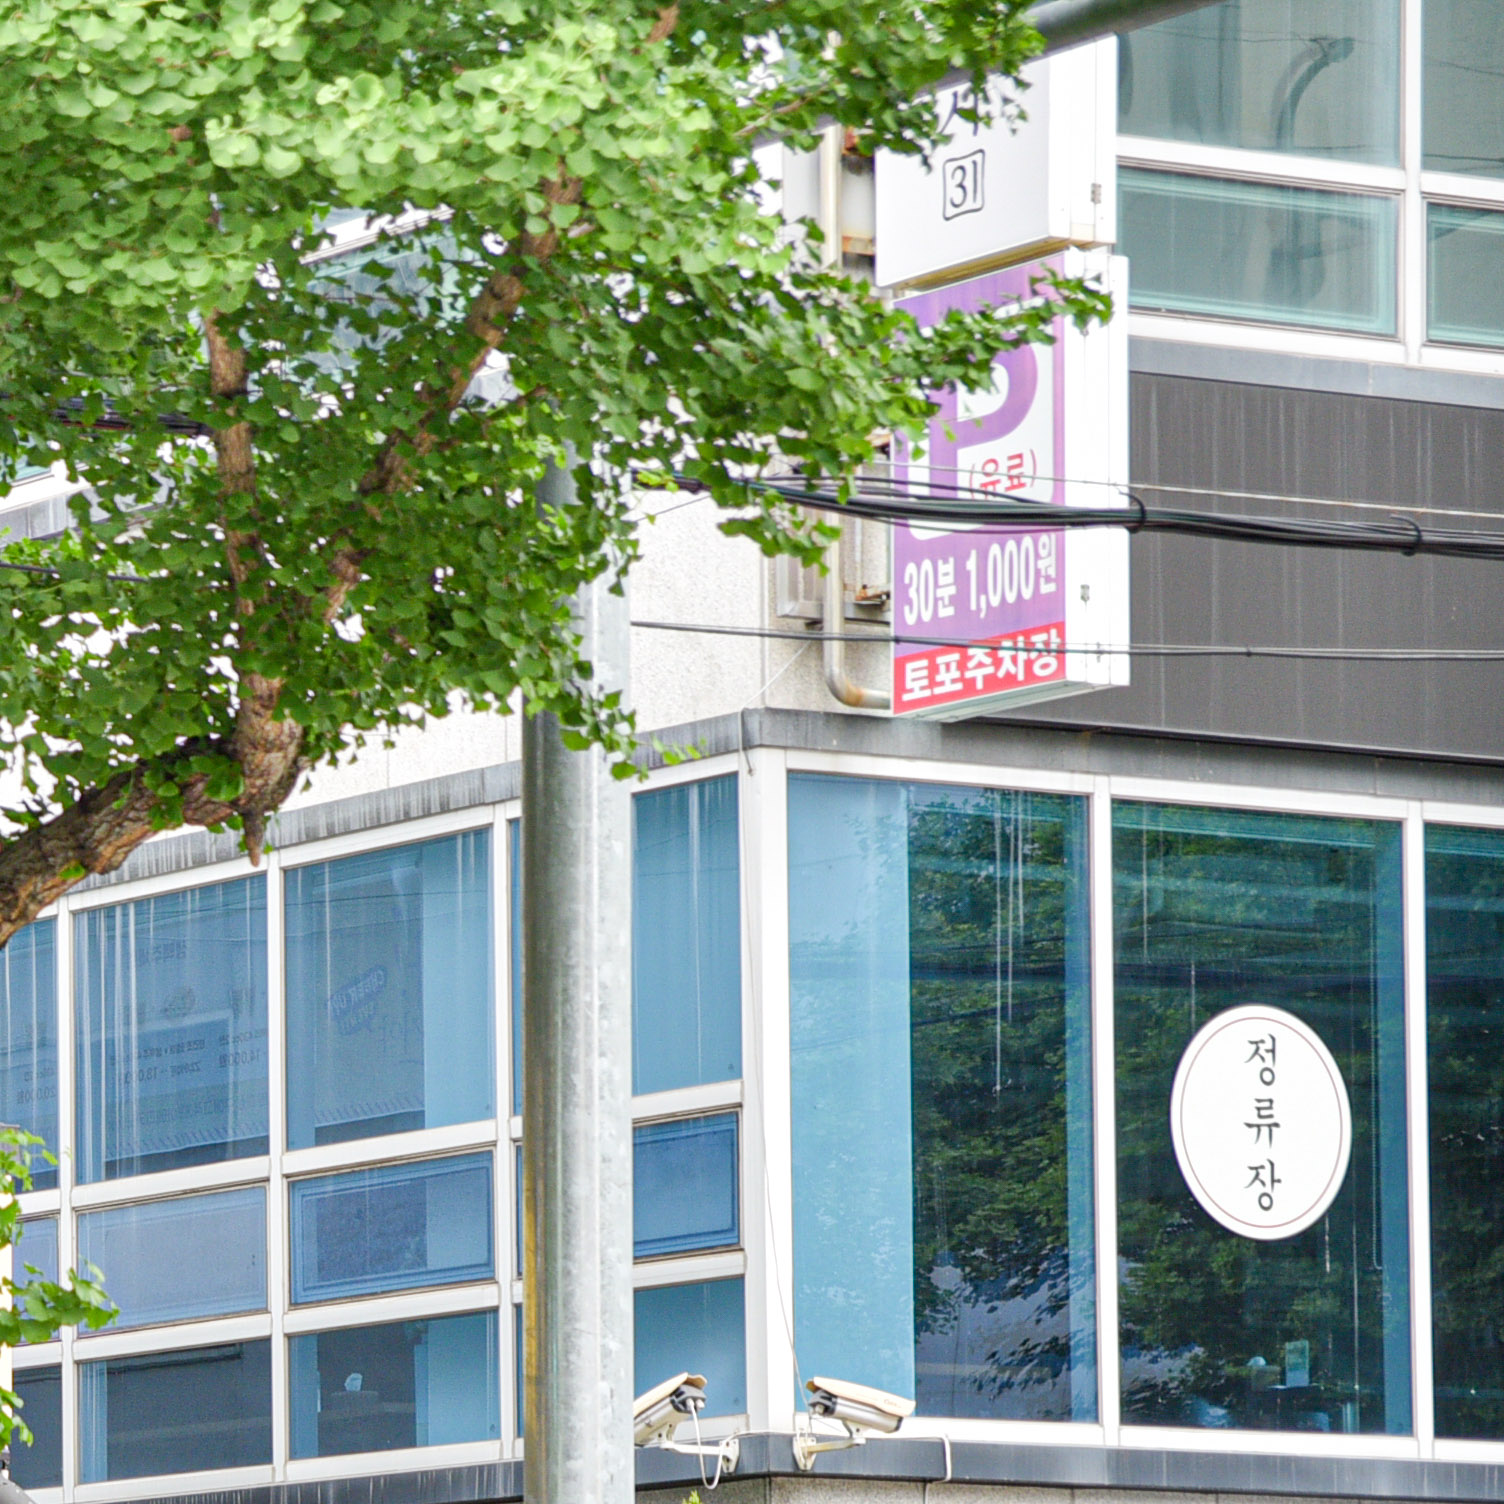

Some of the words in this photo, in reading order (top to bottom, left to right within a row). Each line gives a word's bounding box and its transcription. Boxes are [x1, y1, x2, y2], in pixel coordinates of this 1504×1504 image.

[949, 160, 978, 208] 31
[903, 557, 957, 626] 30분
[966, 533, 1057, 618] 1,000원
[902, 628, 1061, 701] 토포주차장
[1243, 1033, 1283, 1212] 정류장
